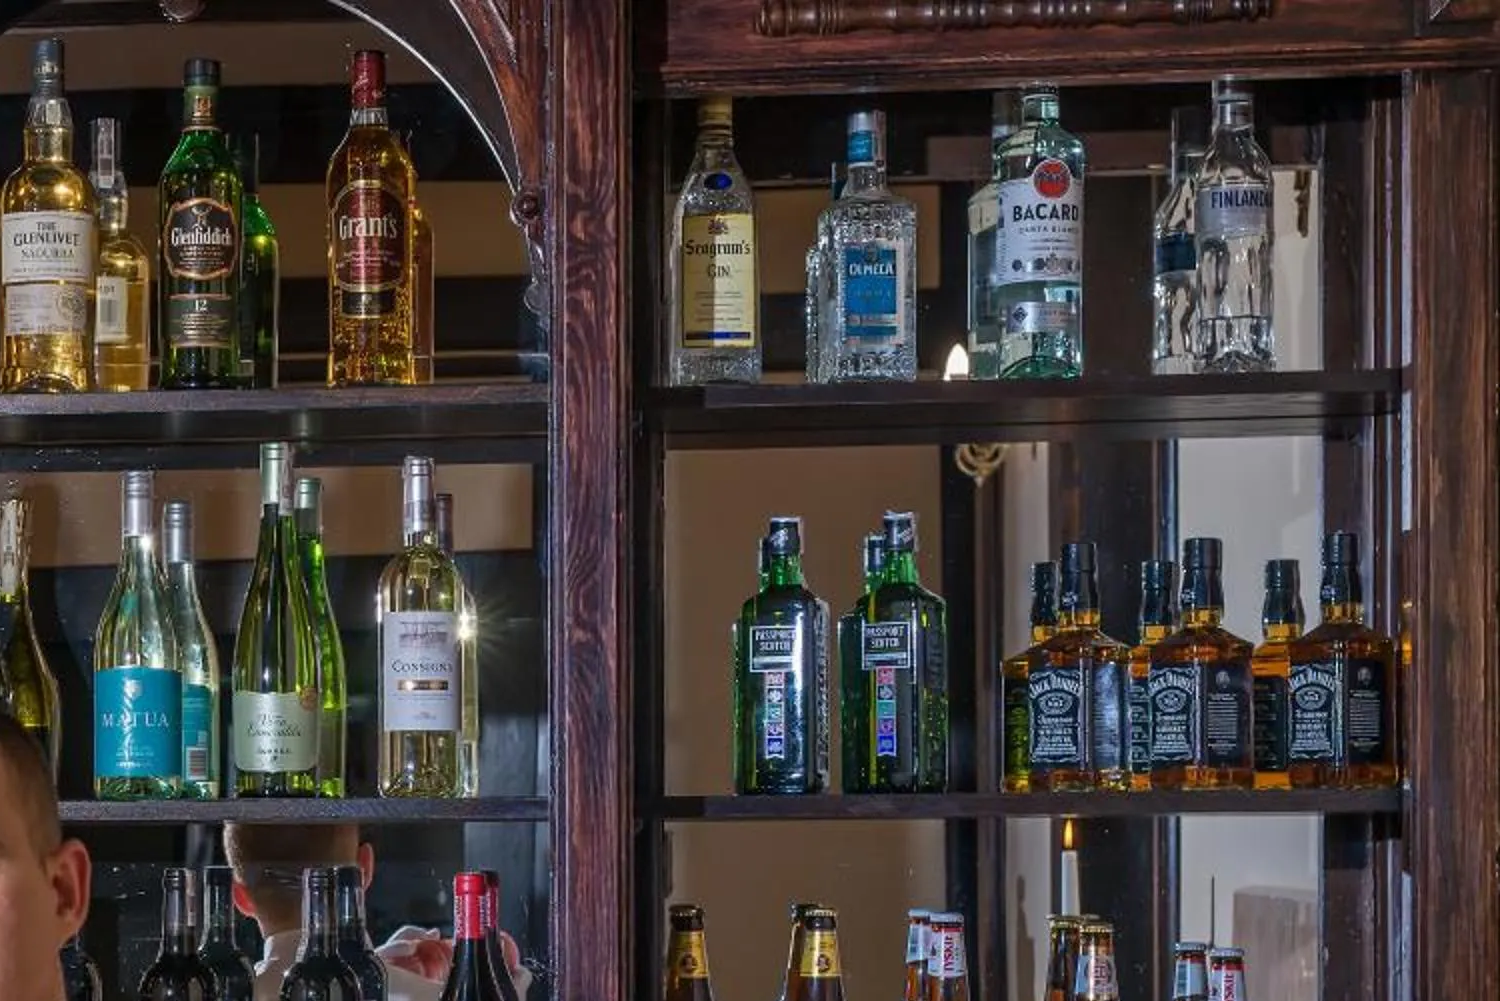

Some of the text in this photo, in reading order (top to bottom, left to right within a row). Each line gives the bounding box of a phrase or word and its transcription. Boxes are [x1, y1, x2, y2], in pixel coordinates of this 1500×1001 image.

[1012, 203, 1079, 222] BACARD
[171, 226, 232, 247] Glenfiddich
[339, 216, 398, 241] Grant's
[13, 232, 80, 247] GLENLIVET
[684, 239, 751, 258] Seagram's
[707, 263, 731, 279] GIN
